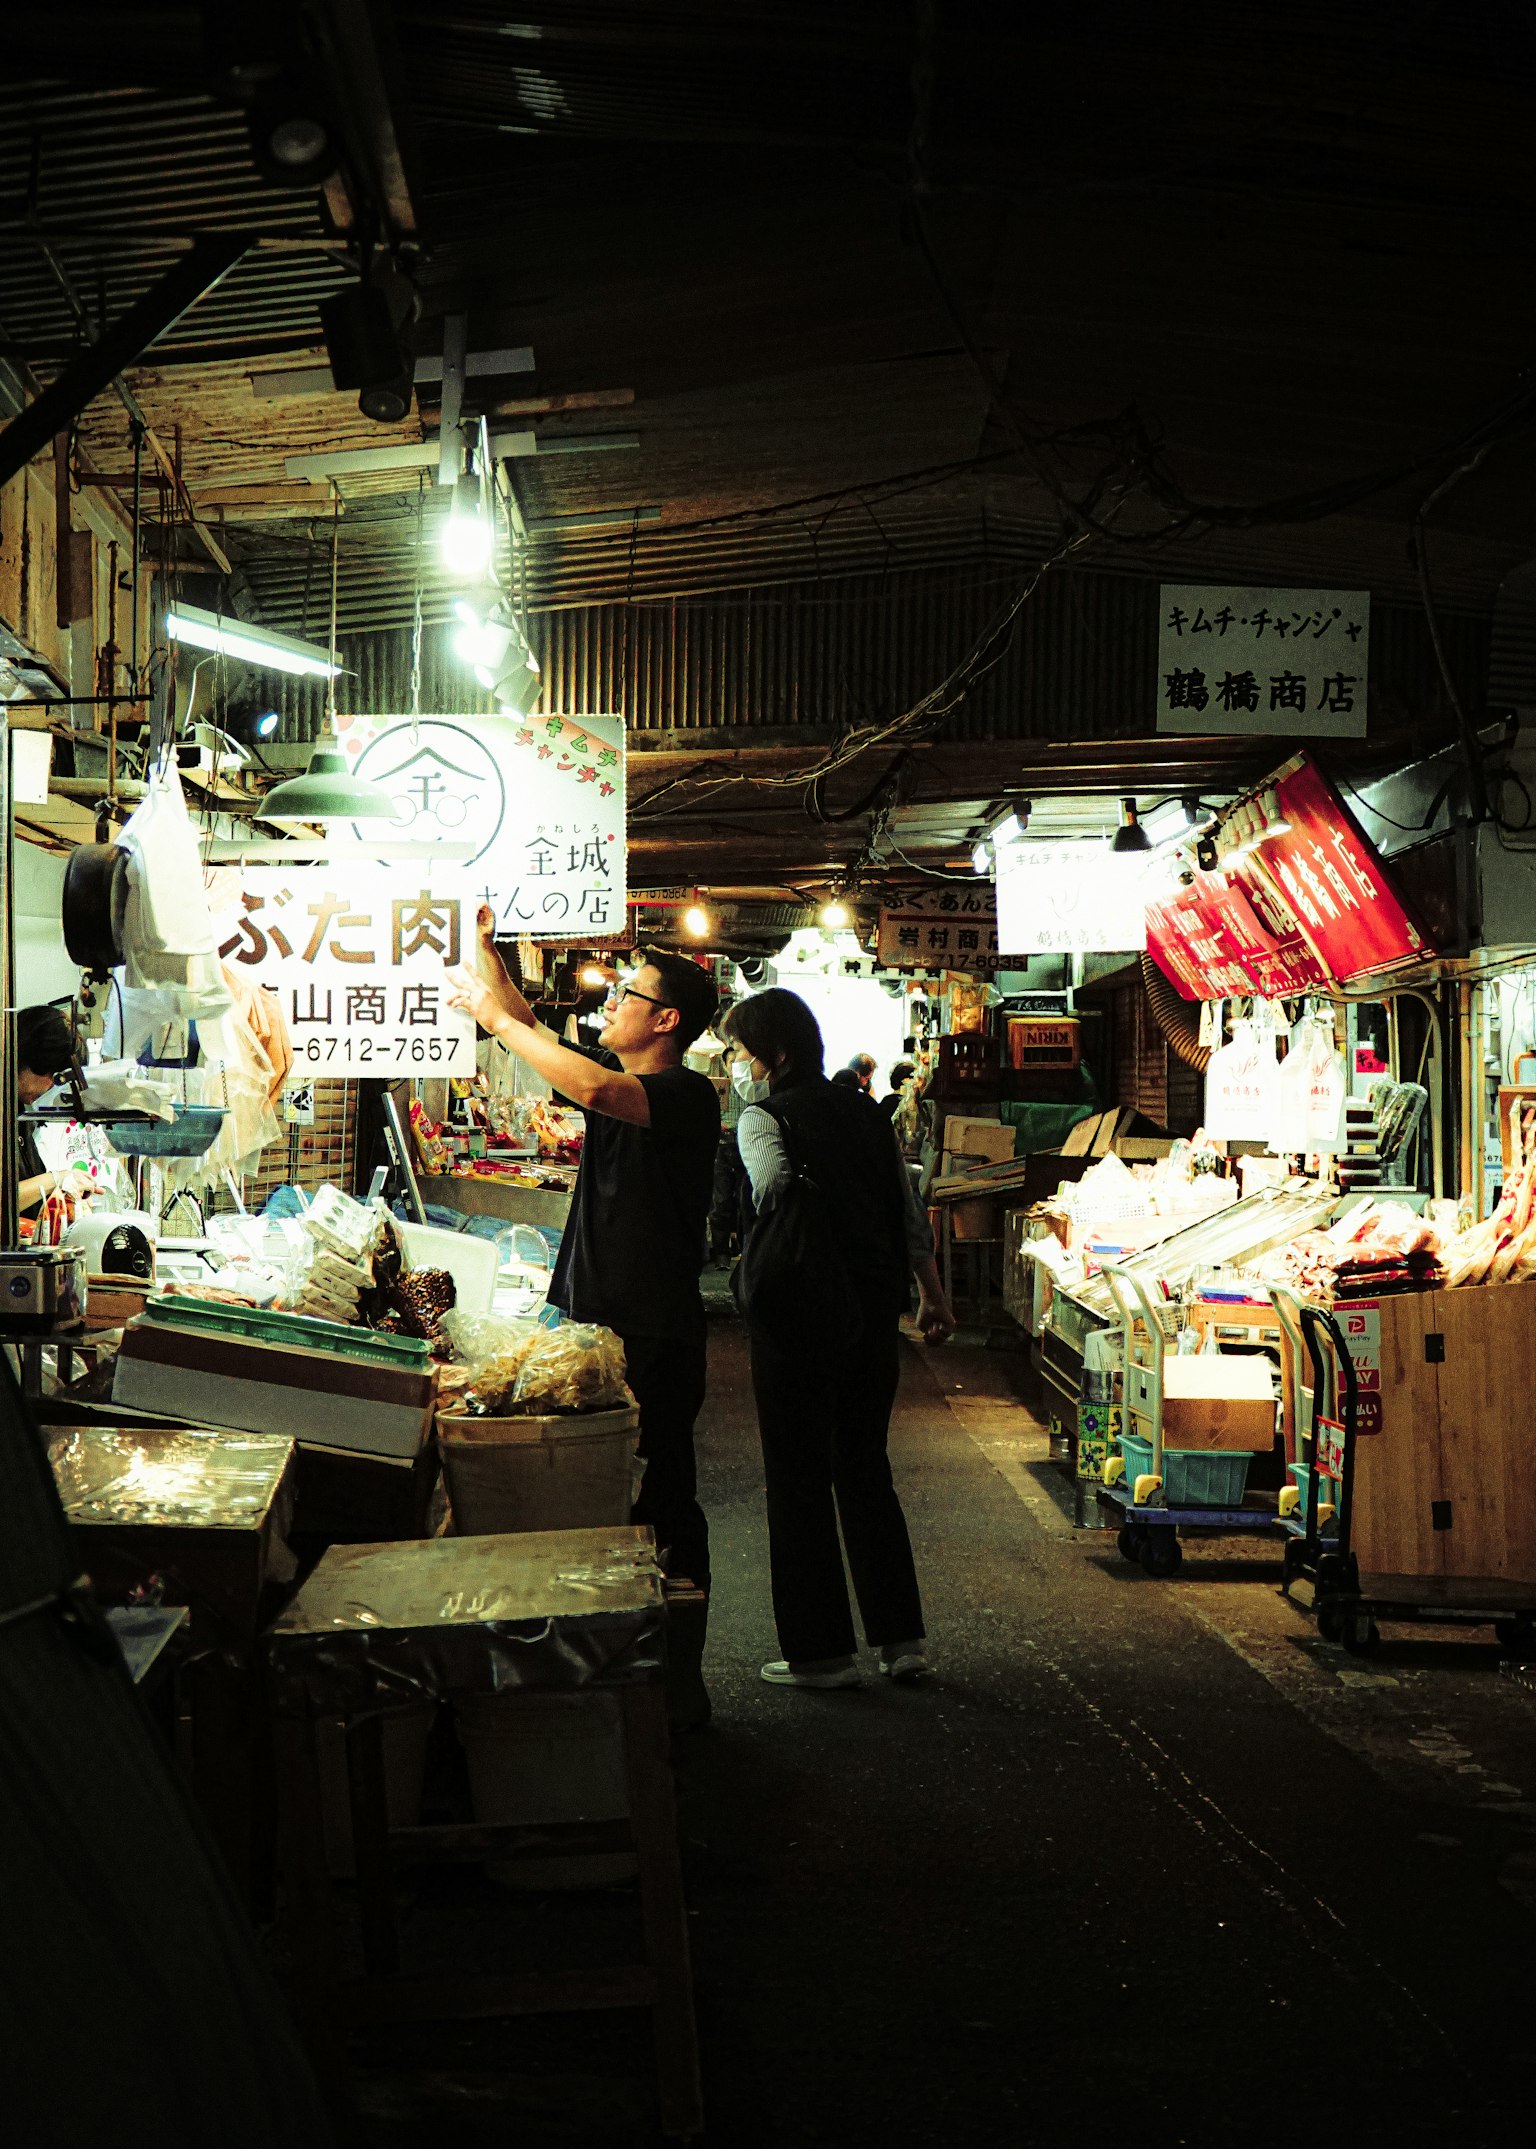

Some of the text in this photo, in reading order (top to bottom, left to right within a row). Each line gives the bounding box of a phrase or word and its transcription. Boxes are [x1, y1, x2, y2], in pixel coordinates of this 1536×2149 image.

[1164, 667, 1358, 713] 鶴橋商店
[545, 716, 617, 767] キムチ
[536, 823, 601, 834] かねしろ
[1015, 853, 1052, 866] キムチ
[217, 887, 462, 967] ぶた肉
[261, 983, 439, 1026] 山商店
[1027, 1032, 1068, 1044] KIRIN
[1356, 1371, 1373, 1384] AY
